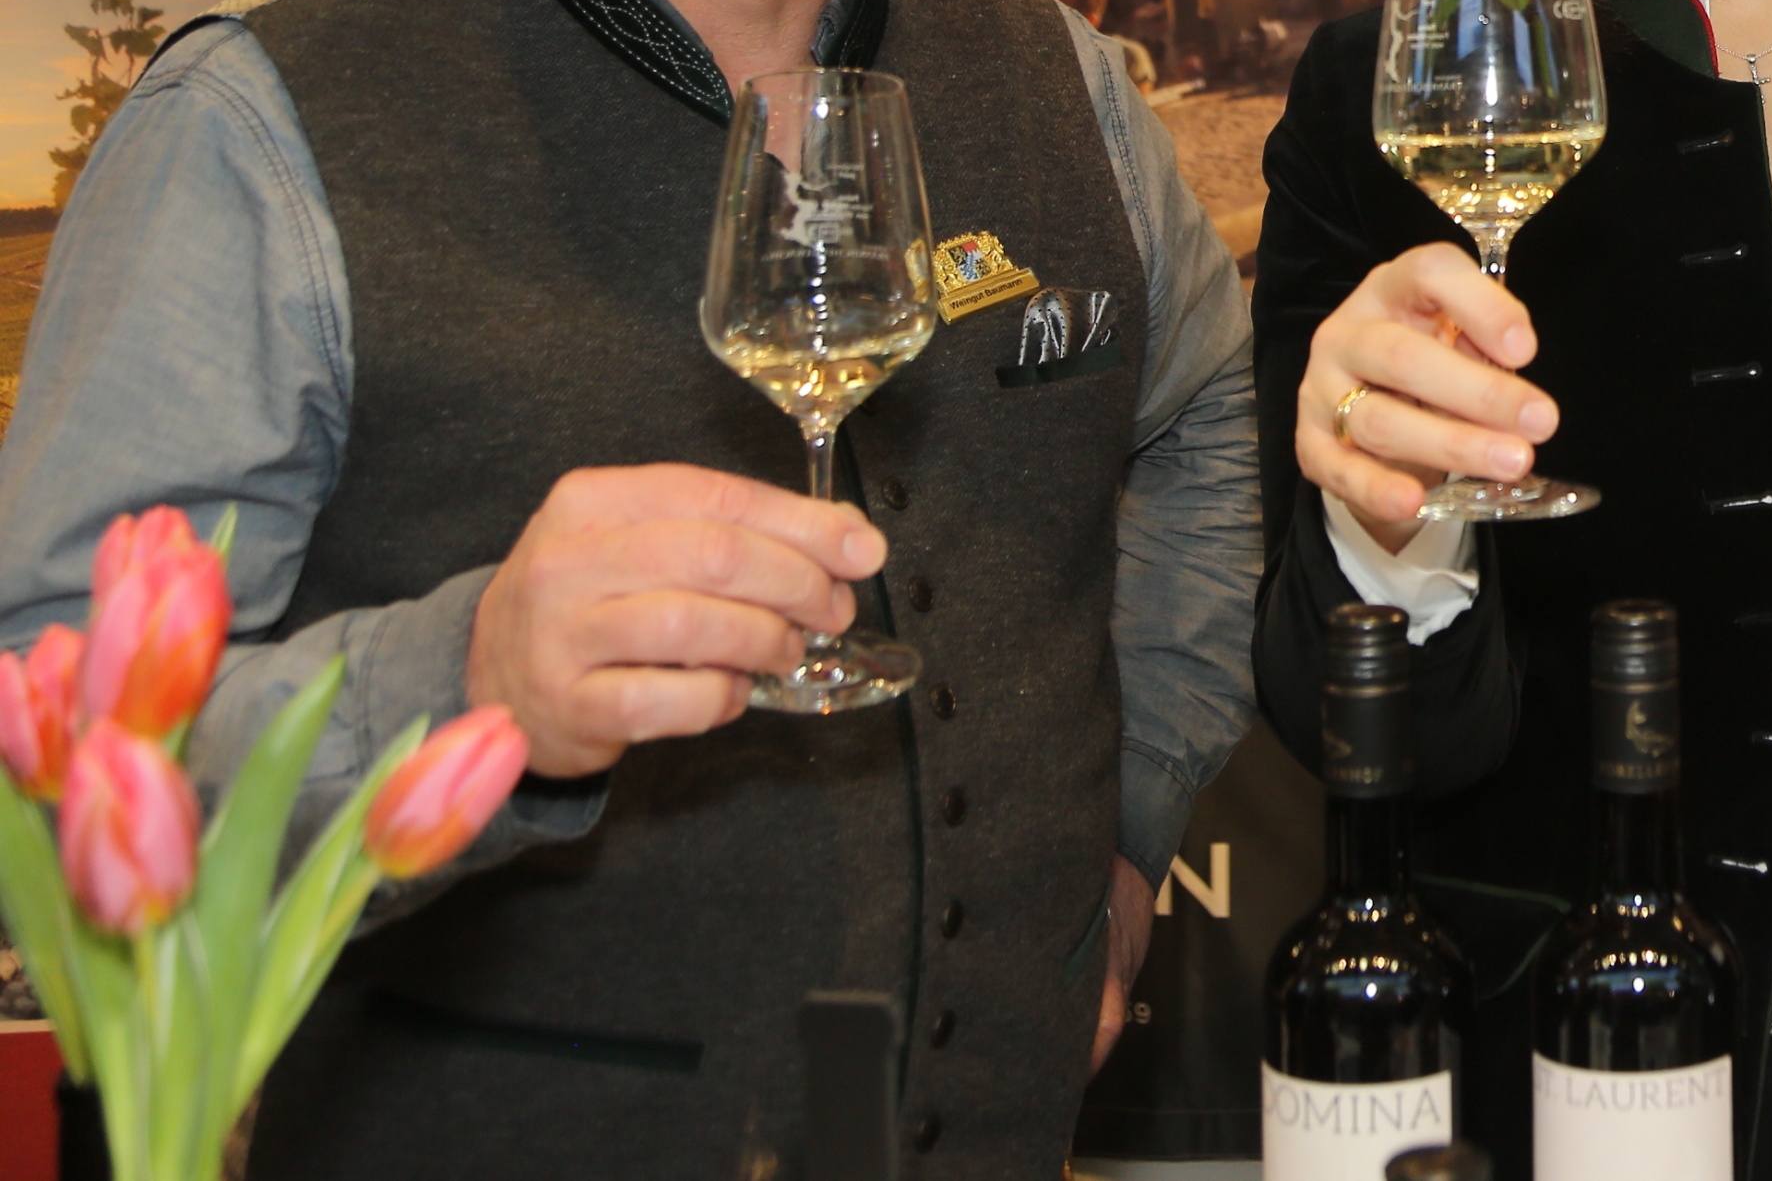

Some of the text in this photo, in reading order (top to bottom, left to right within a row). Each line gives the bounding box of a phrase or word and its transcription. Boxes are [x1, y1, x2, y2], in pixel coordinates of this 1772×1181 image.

[949, 278, 1023, 310] Weingut Baumann
[1565, 1066, 1728, 1111] LAURENT
